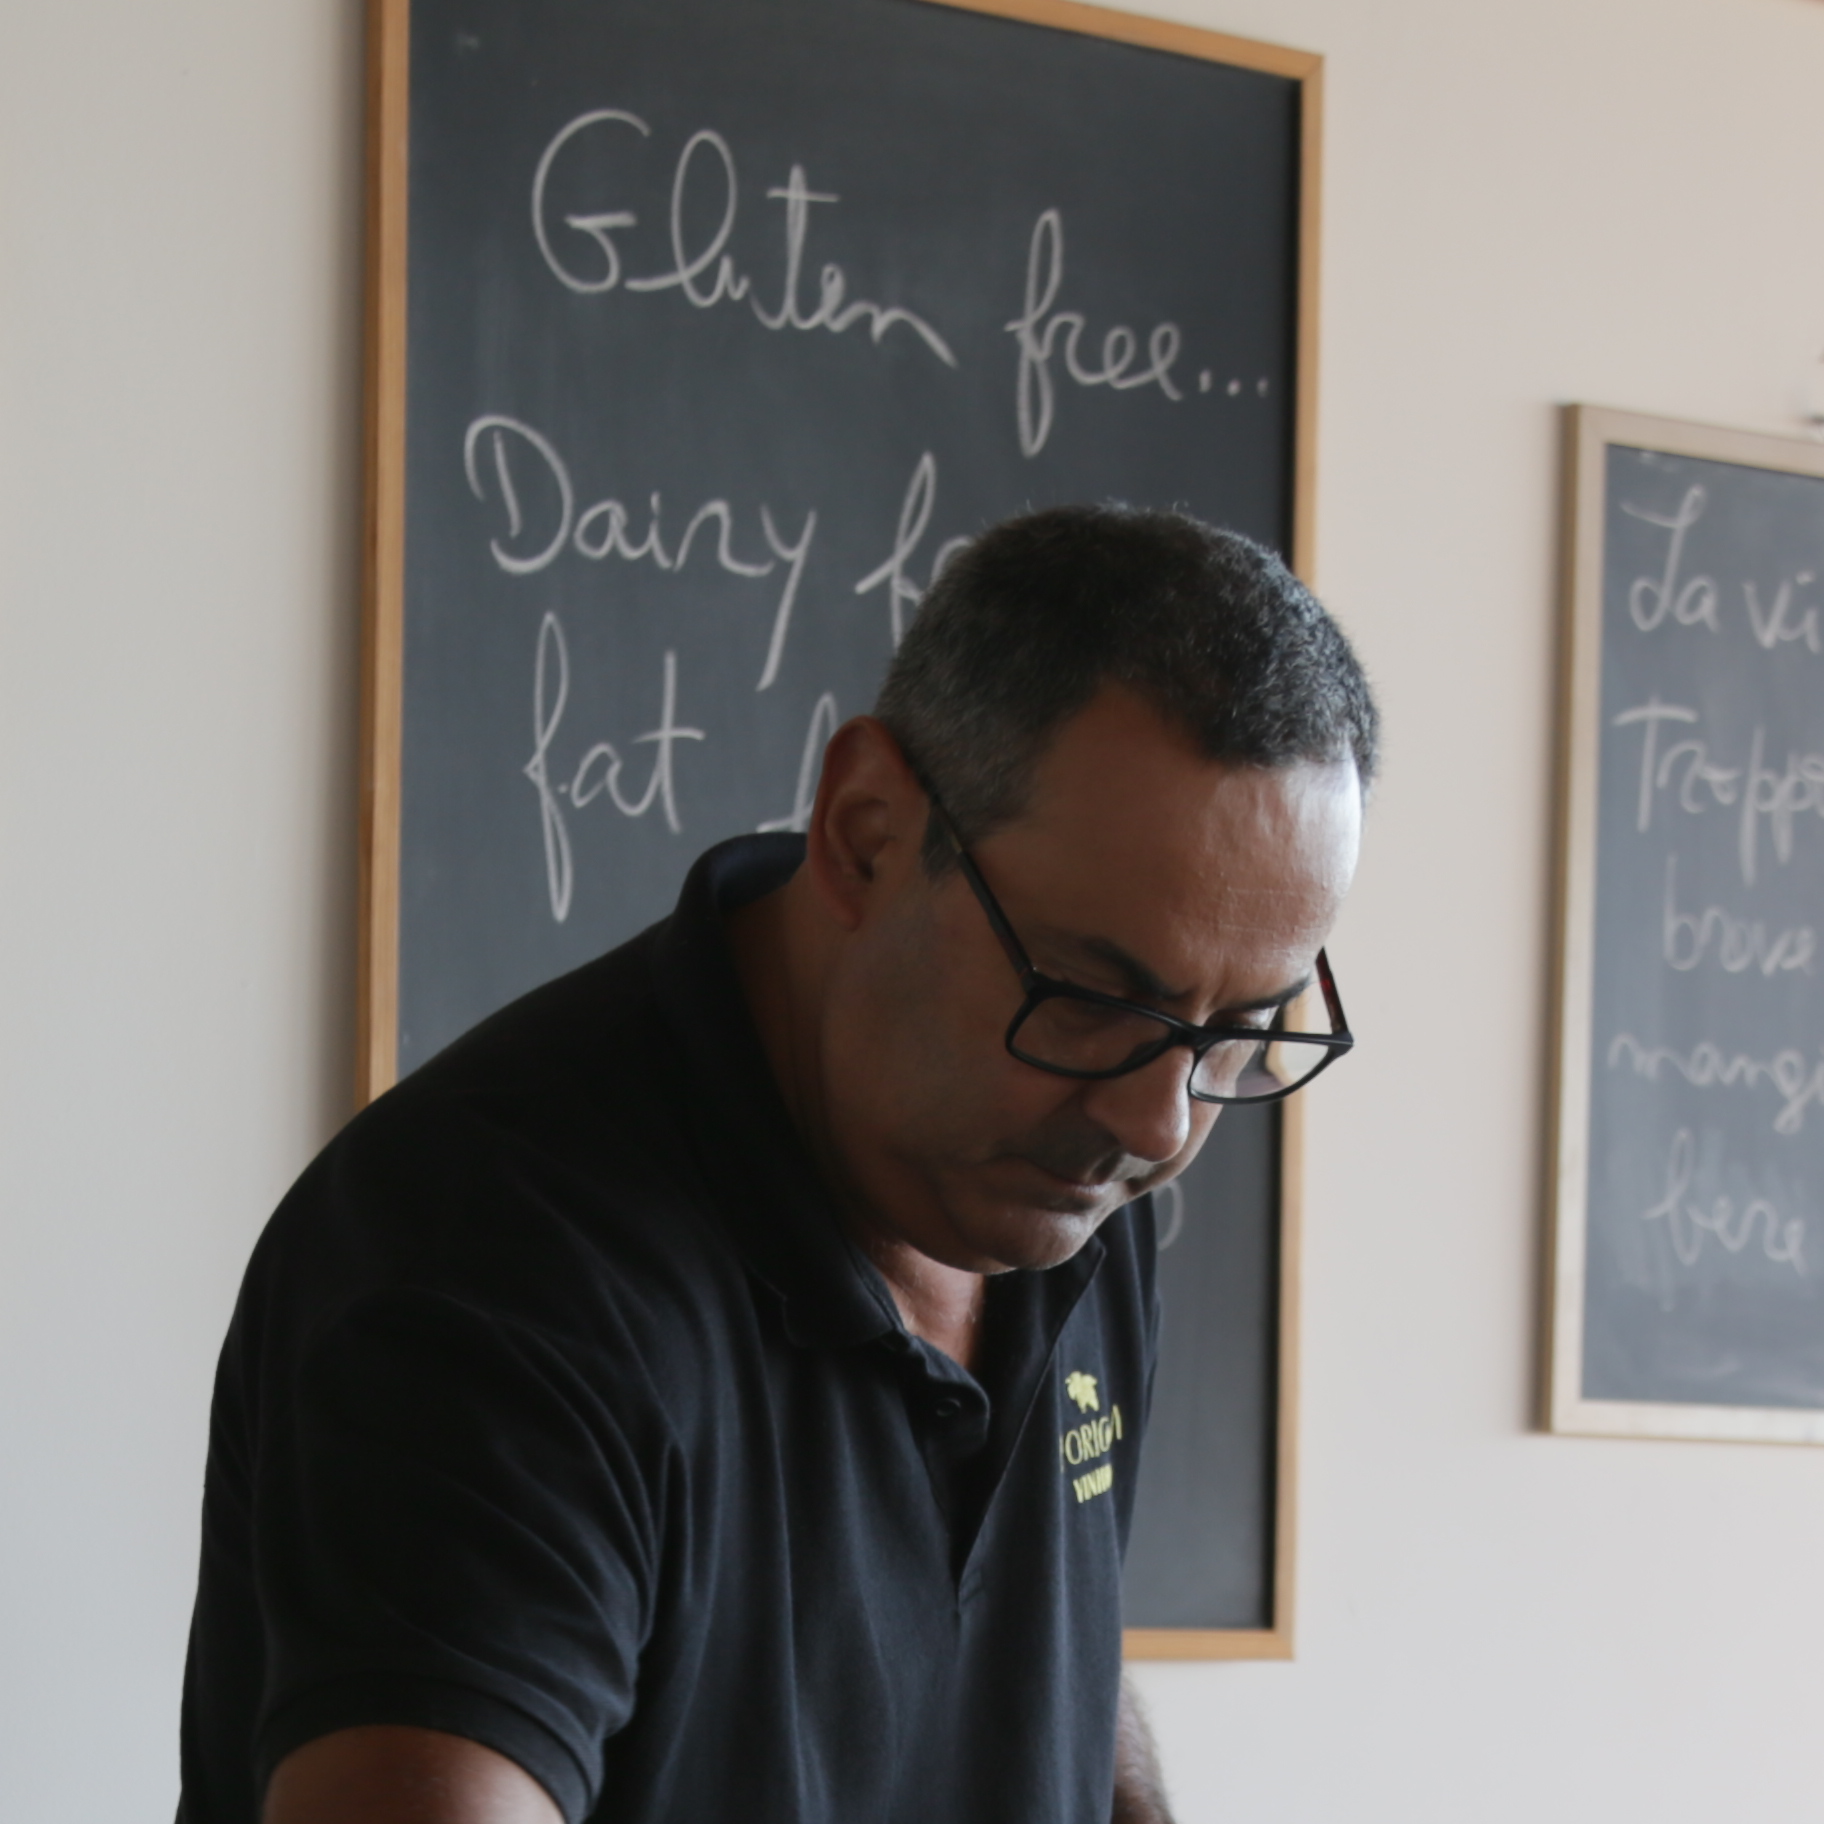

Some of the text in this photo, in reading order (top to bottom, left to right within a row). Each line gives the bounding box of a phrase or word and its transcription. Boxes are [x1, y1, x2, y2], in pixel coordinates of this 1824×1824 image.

[532, 108, 958, 367] Gluten
[464, 415, 815, 692] Dairy
[524, 612, 705, 922] fat
